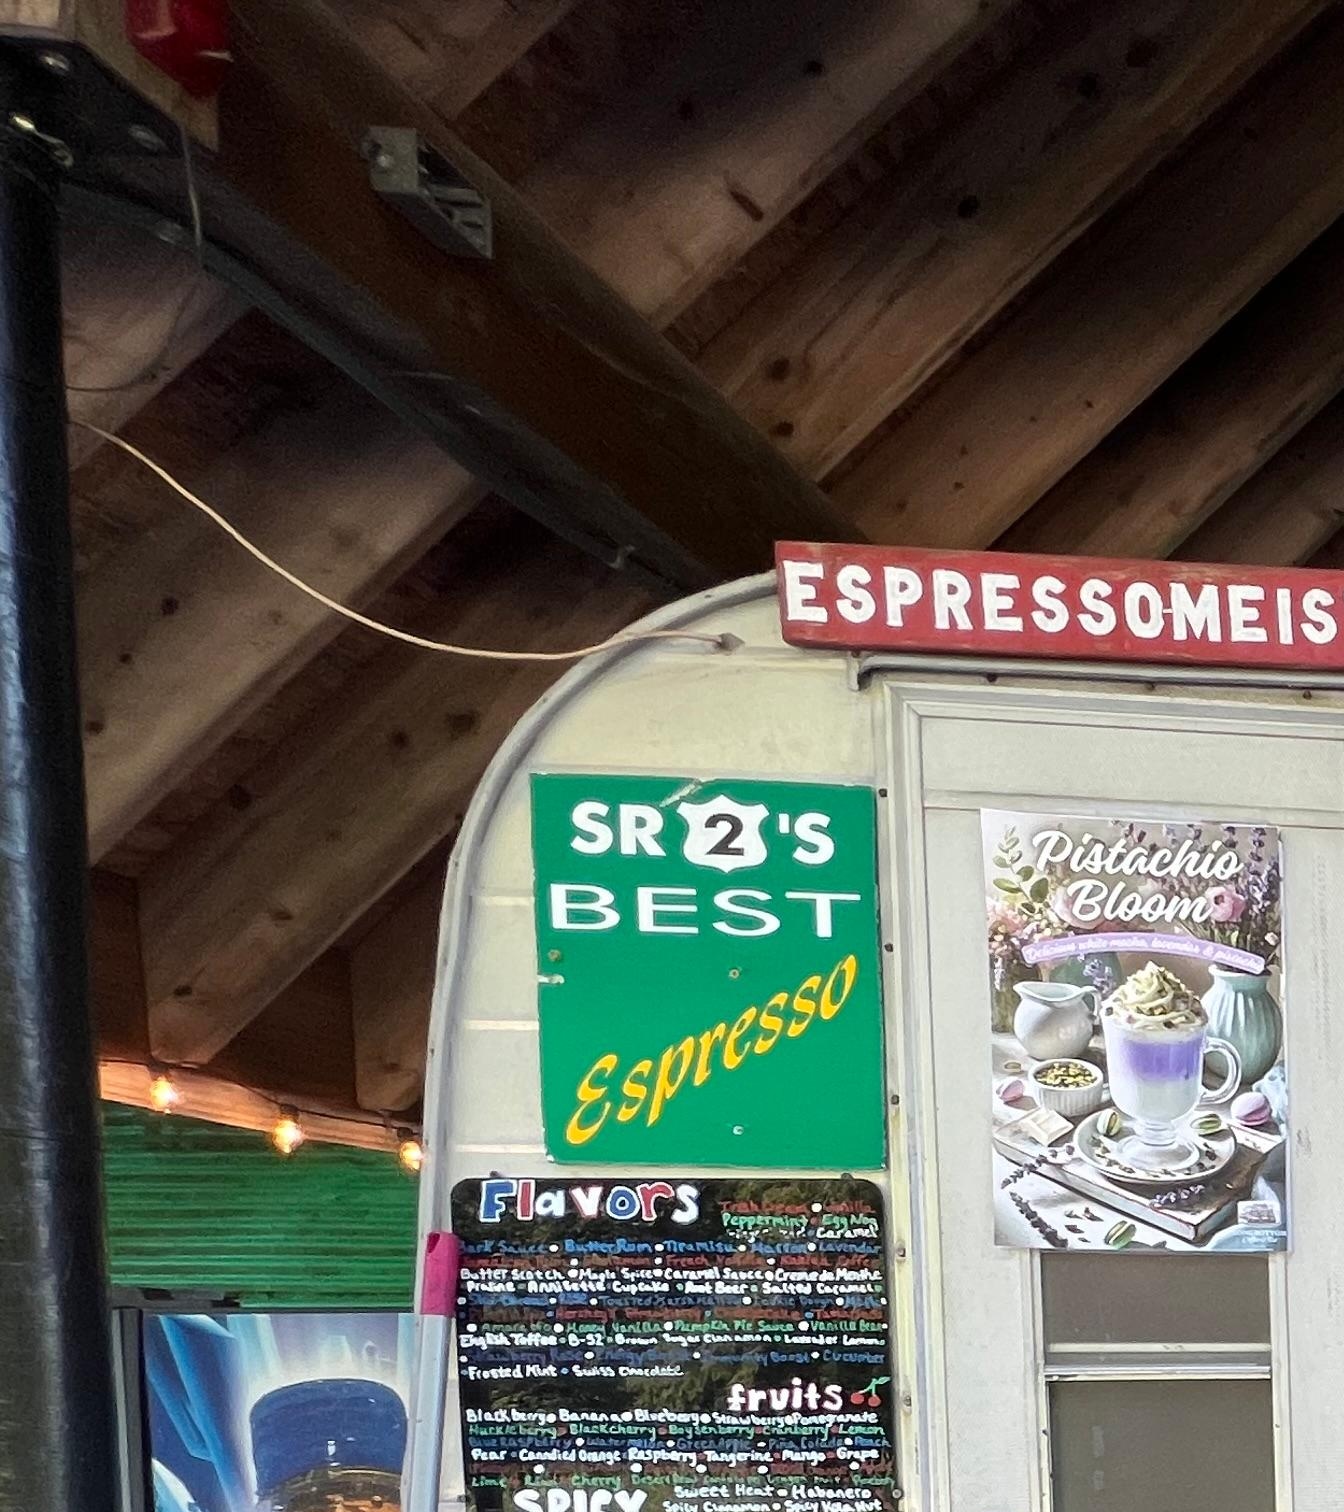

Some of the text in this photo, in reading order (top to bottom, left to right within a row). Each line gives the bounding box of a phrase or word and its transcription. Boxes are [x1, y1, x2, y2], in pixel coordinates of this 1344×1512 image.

[571, 801, 666, 857] SR
[1032, 829, 1244, 881] Pistachio
[550, 883, 861, 938] BEST
[1068, 879, 1212, 924] Bloom
[566, 954, 857, 1144] Espresso
[479, 1178, 699, 1225] Flavors
[816, 1227, 877, 1239] Caramel
[664, 1267, 720, 1280] Caramel
[468, 1366, 523, 1380] Frosted
[526, 1364, 557, 1377] Mint
[727, 1377, 843, 1411] fruits
[559, 1409, 619, 1422] Banana
[705, 1450, 773, 1467] Tangerine
[782, 1450, 826, 1466] Mango
[837, 1447, 879, 1463] Grape
[674, 1484, 872, 1499] Sweet Heat Habanero
